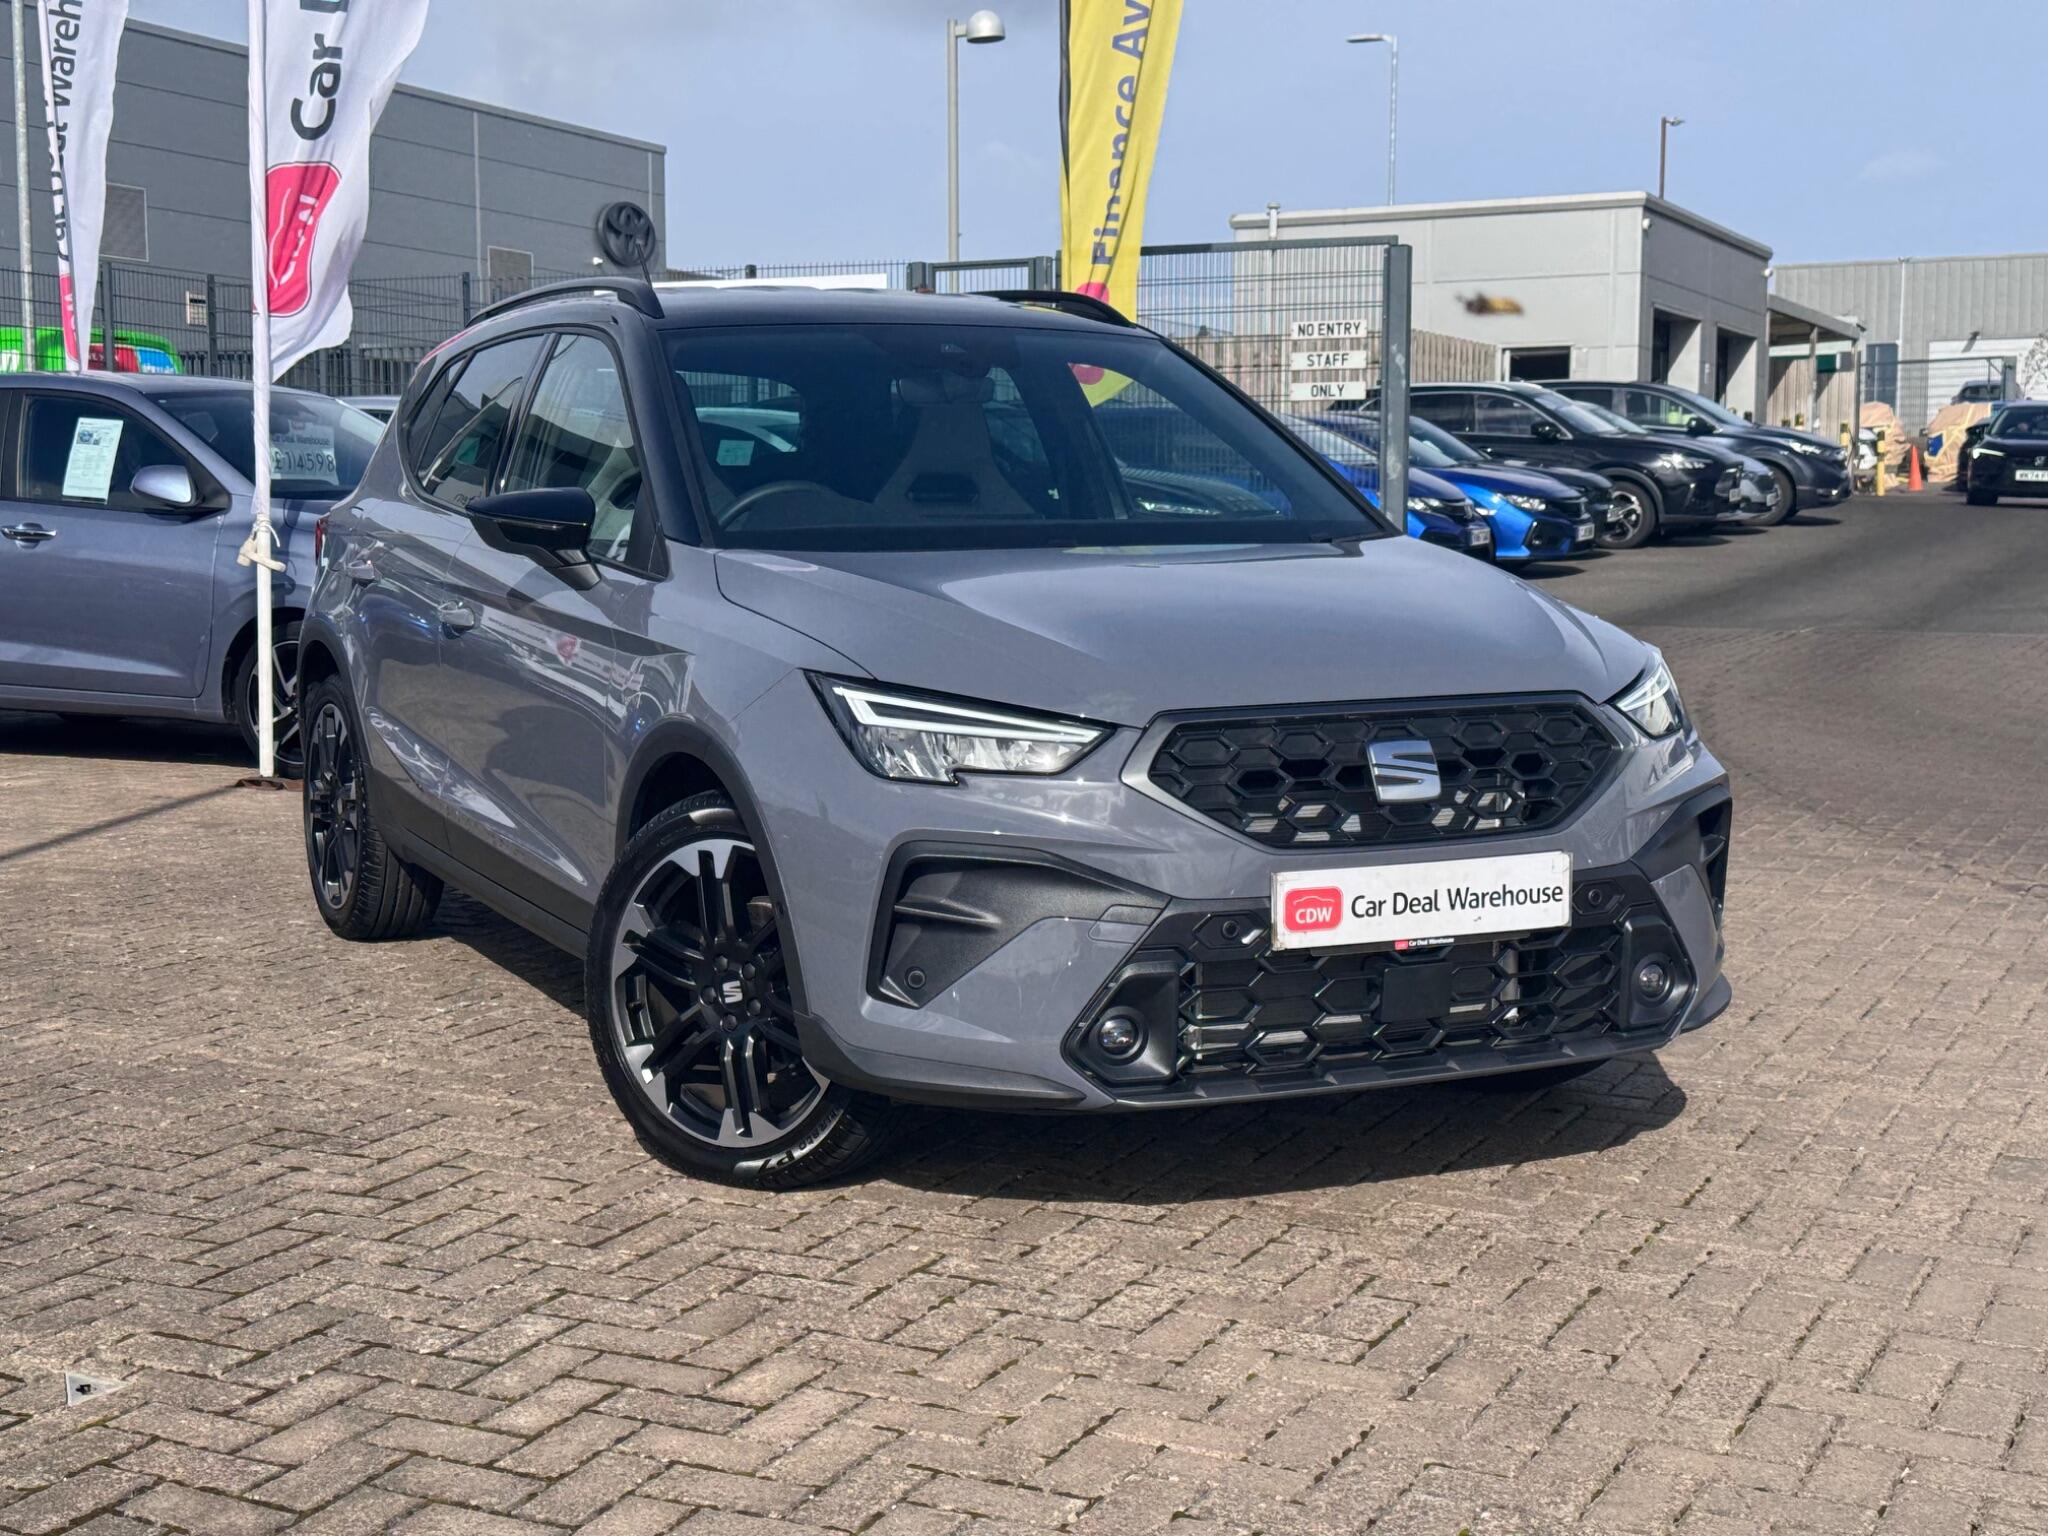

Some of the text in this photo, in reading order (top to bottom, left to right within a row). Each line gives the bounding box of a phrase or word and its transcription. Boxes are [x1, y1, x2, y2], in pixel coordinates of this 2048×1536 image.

[290, 32, 343, 140] Car
[1091, 75, 1136, 266] Finance
[1297, 321, 1361, 337] NO ENTRY
[1307, 352, 1350, 367] STAFF
[1311, 383, 1345, 398] ONLY
[1351, 883, 1564, 919] Car Deal Warehouse
[1295, 907, 1333, 925] CDW
